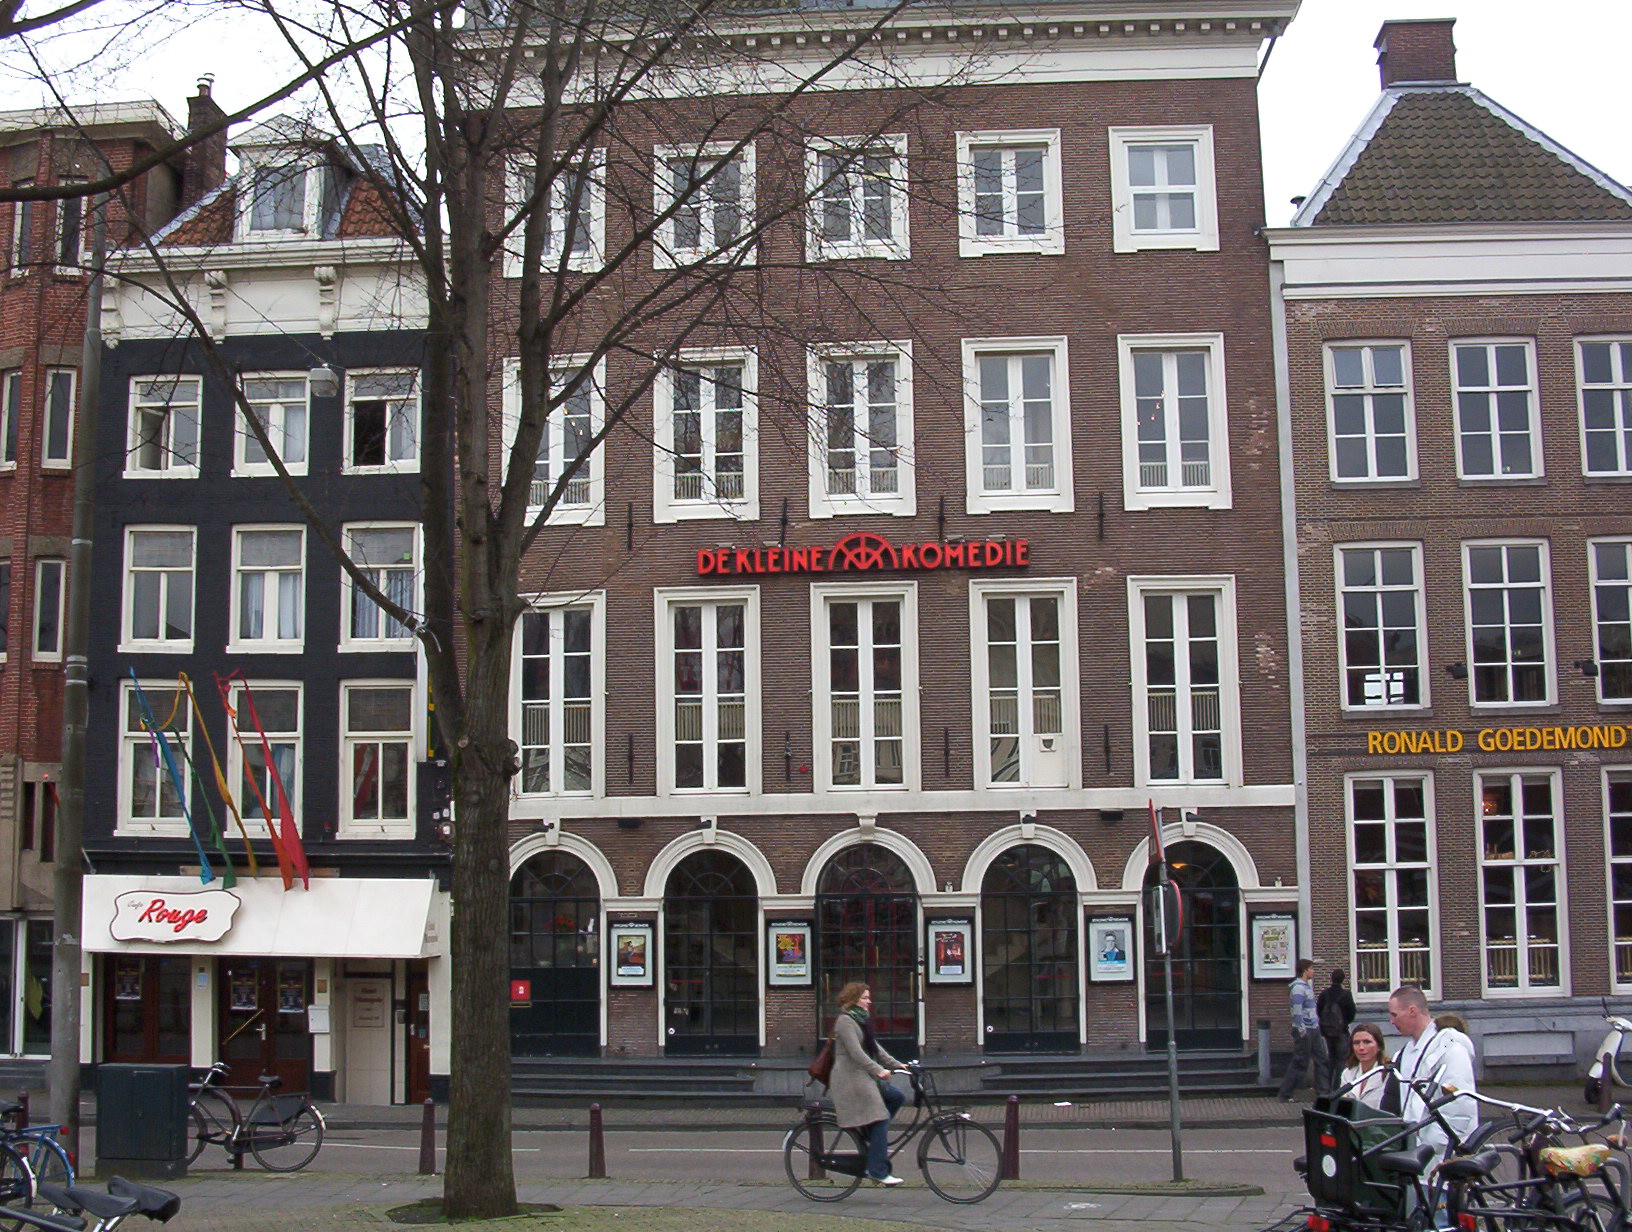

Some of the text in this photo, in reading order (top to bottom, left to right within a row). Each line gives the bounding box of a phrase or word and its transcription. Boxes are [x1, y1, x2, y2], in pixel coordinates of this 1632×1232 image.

[697, 540, 1030, 574] DE KLEINE KOMEDIE
[1367, 730, 1464, 753] RONALD
[137, 898, 208, 933] Rouge
